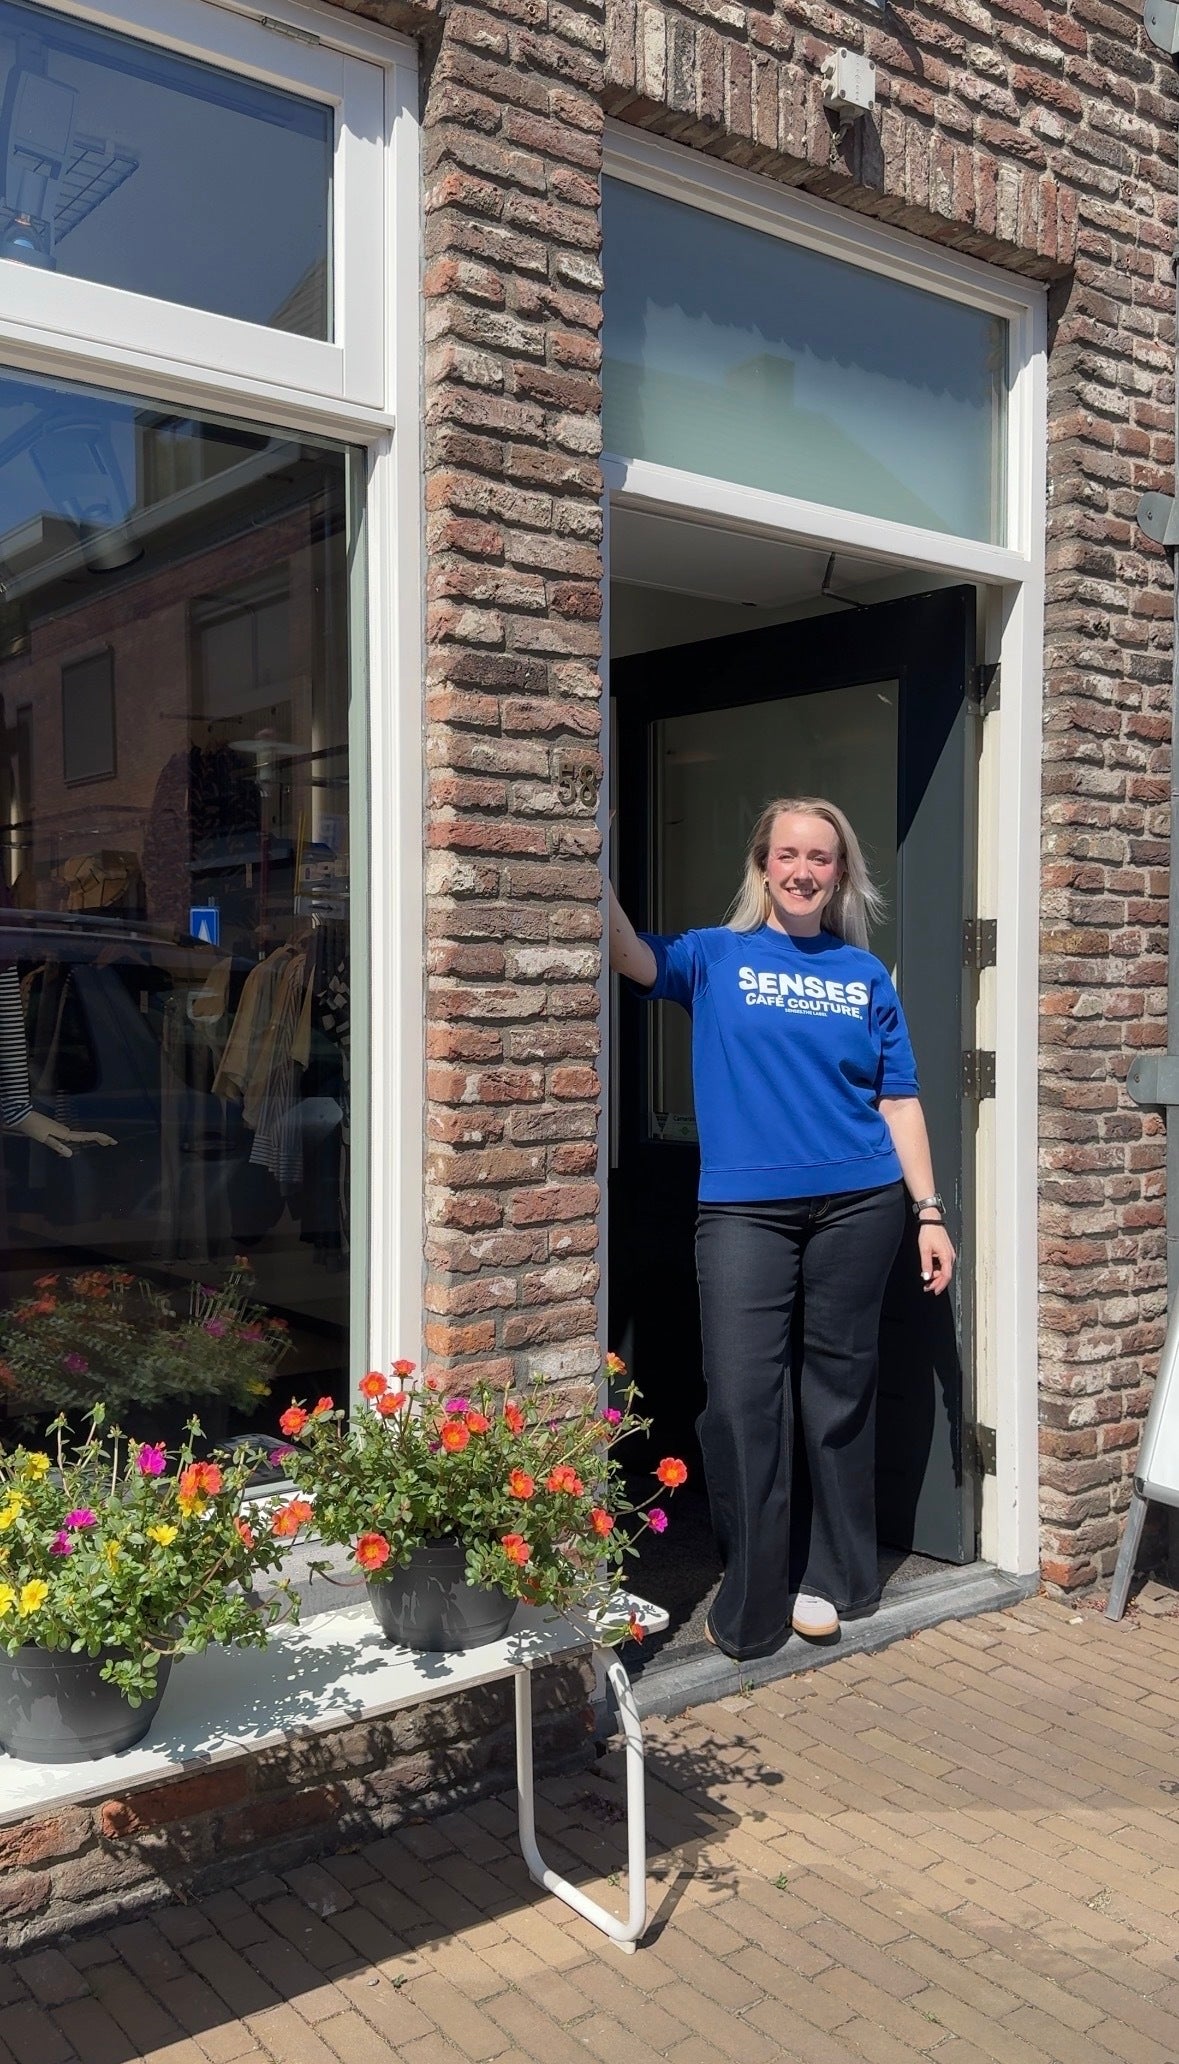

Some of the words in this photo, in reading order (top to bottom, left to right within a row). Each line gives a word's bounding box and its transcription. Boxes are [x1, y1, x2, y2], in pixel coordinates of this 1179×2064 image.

[558, 762, 597, 806] 58
[738, 966, 869, 1006] SENSES
[745, 993, 785, 1008] CAFÉ
